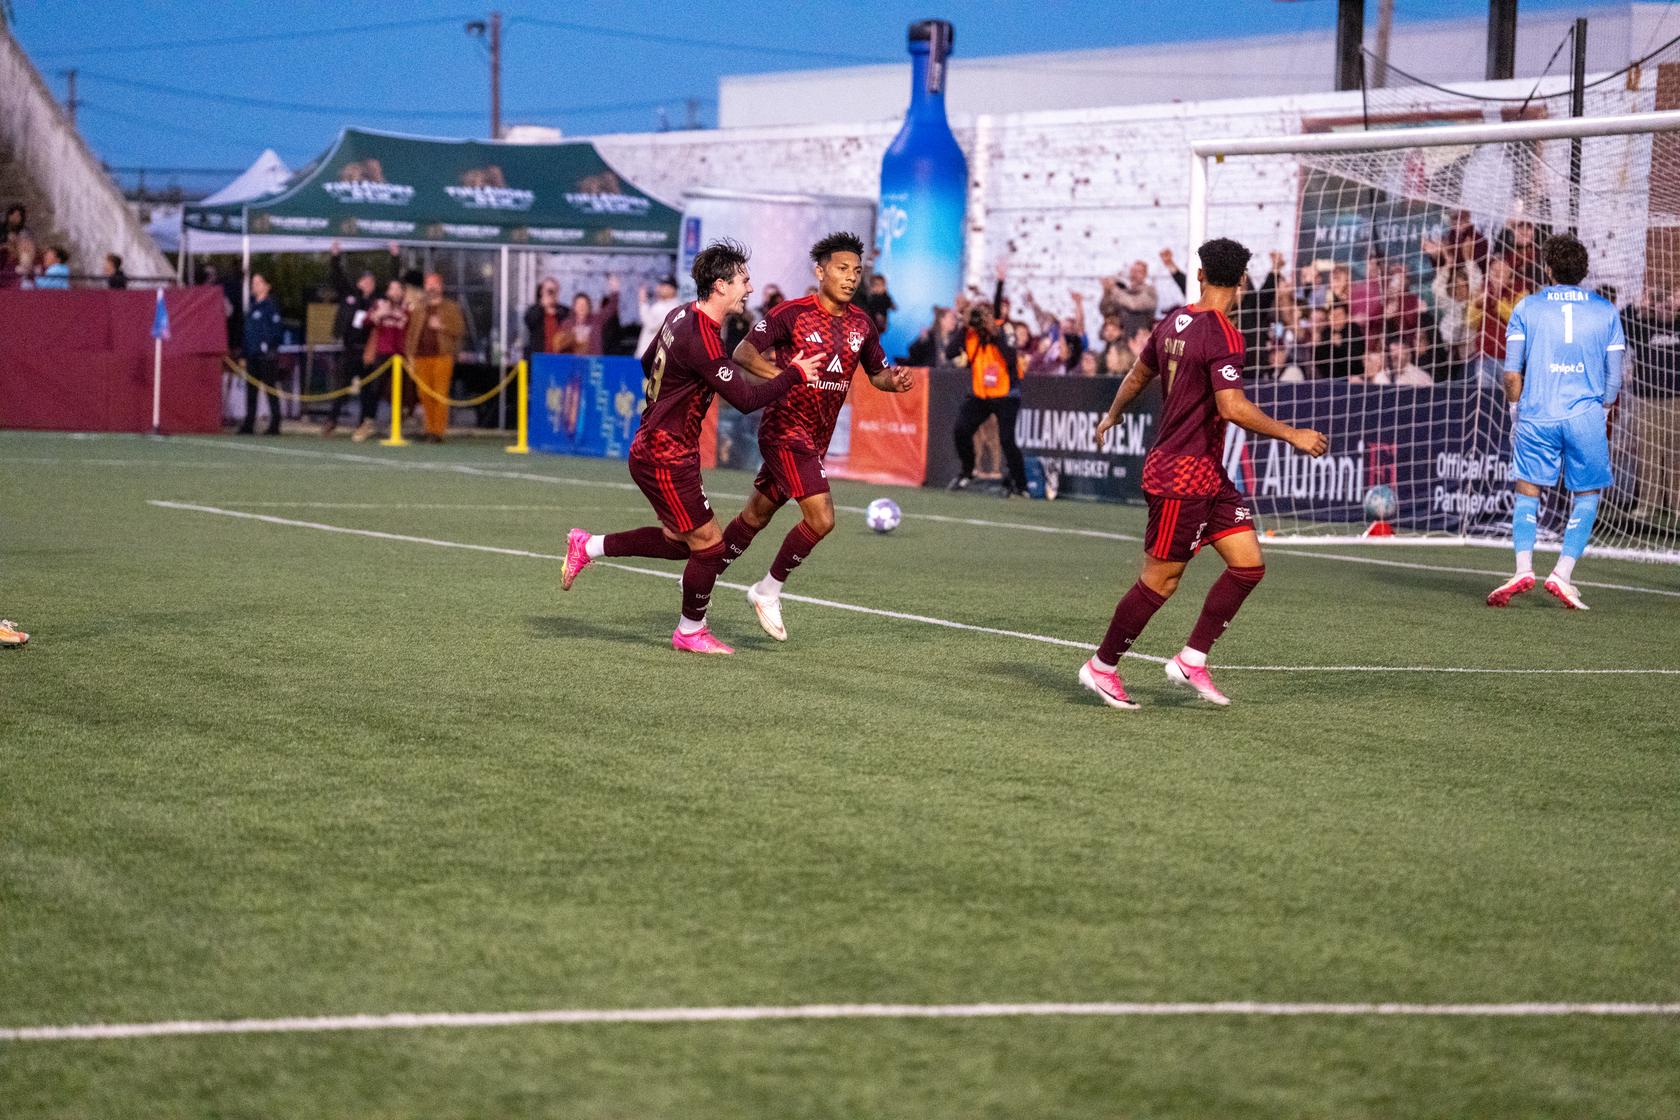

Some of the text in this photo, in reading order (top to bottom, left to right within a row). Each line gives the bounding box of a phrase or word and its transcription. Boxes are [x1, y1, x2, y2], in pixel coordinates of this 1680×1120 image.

[1561, 302, 1573, 344] 1
[1167, 360, 1178, 394] 7
[1549, 362, 1576, 375] Shipt
[1014, 408, 1098, 453] ULLAMORE
[1063, 459, 1110, 478] WHISKEY
[1436, 452, 1514, 482] Official Fina
[1432, 485, 1485, 515] Partner
[1483, 489, 1502, 514] of
